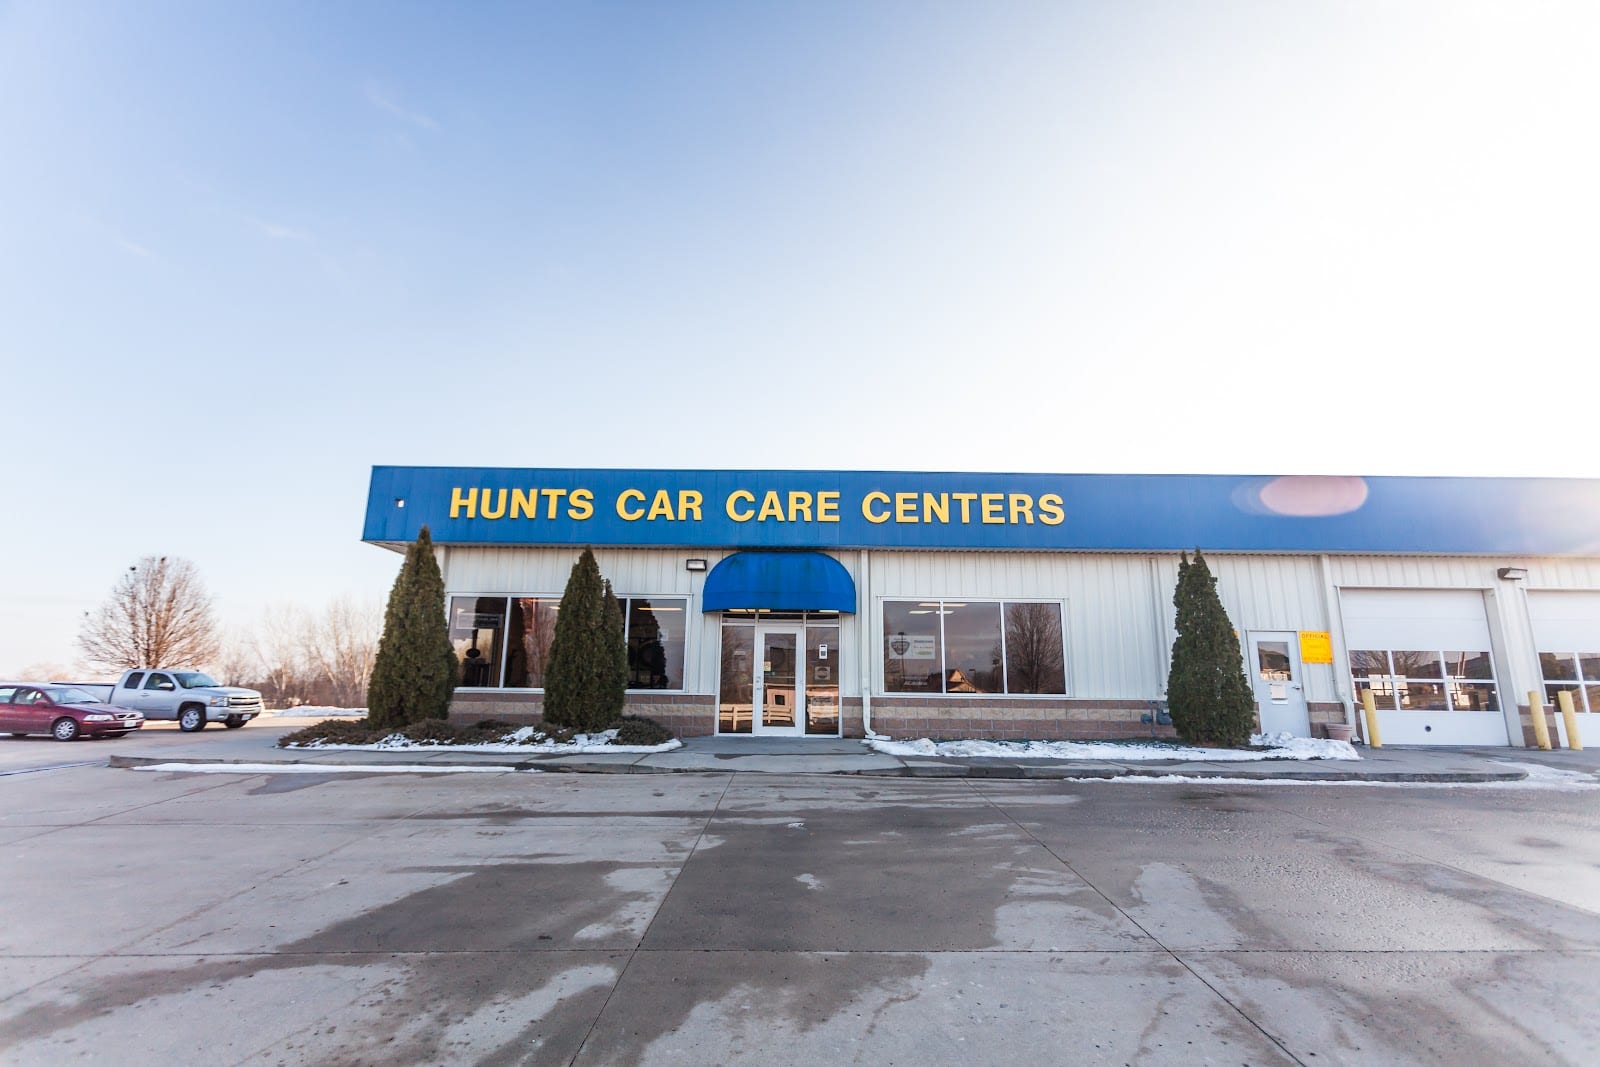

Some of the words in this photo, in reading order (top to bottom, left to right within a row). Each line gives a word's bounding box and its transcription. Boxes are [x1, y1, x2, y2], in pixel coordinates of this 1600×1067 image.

[449, 487, 595, 521] HUNTS
[615, 489, 704, 522] CAR
[725, 490, 841, 523] CARE
[861, 492, 1065, 526] CENTERS
